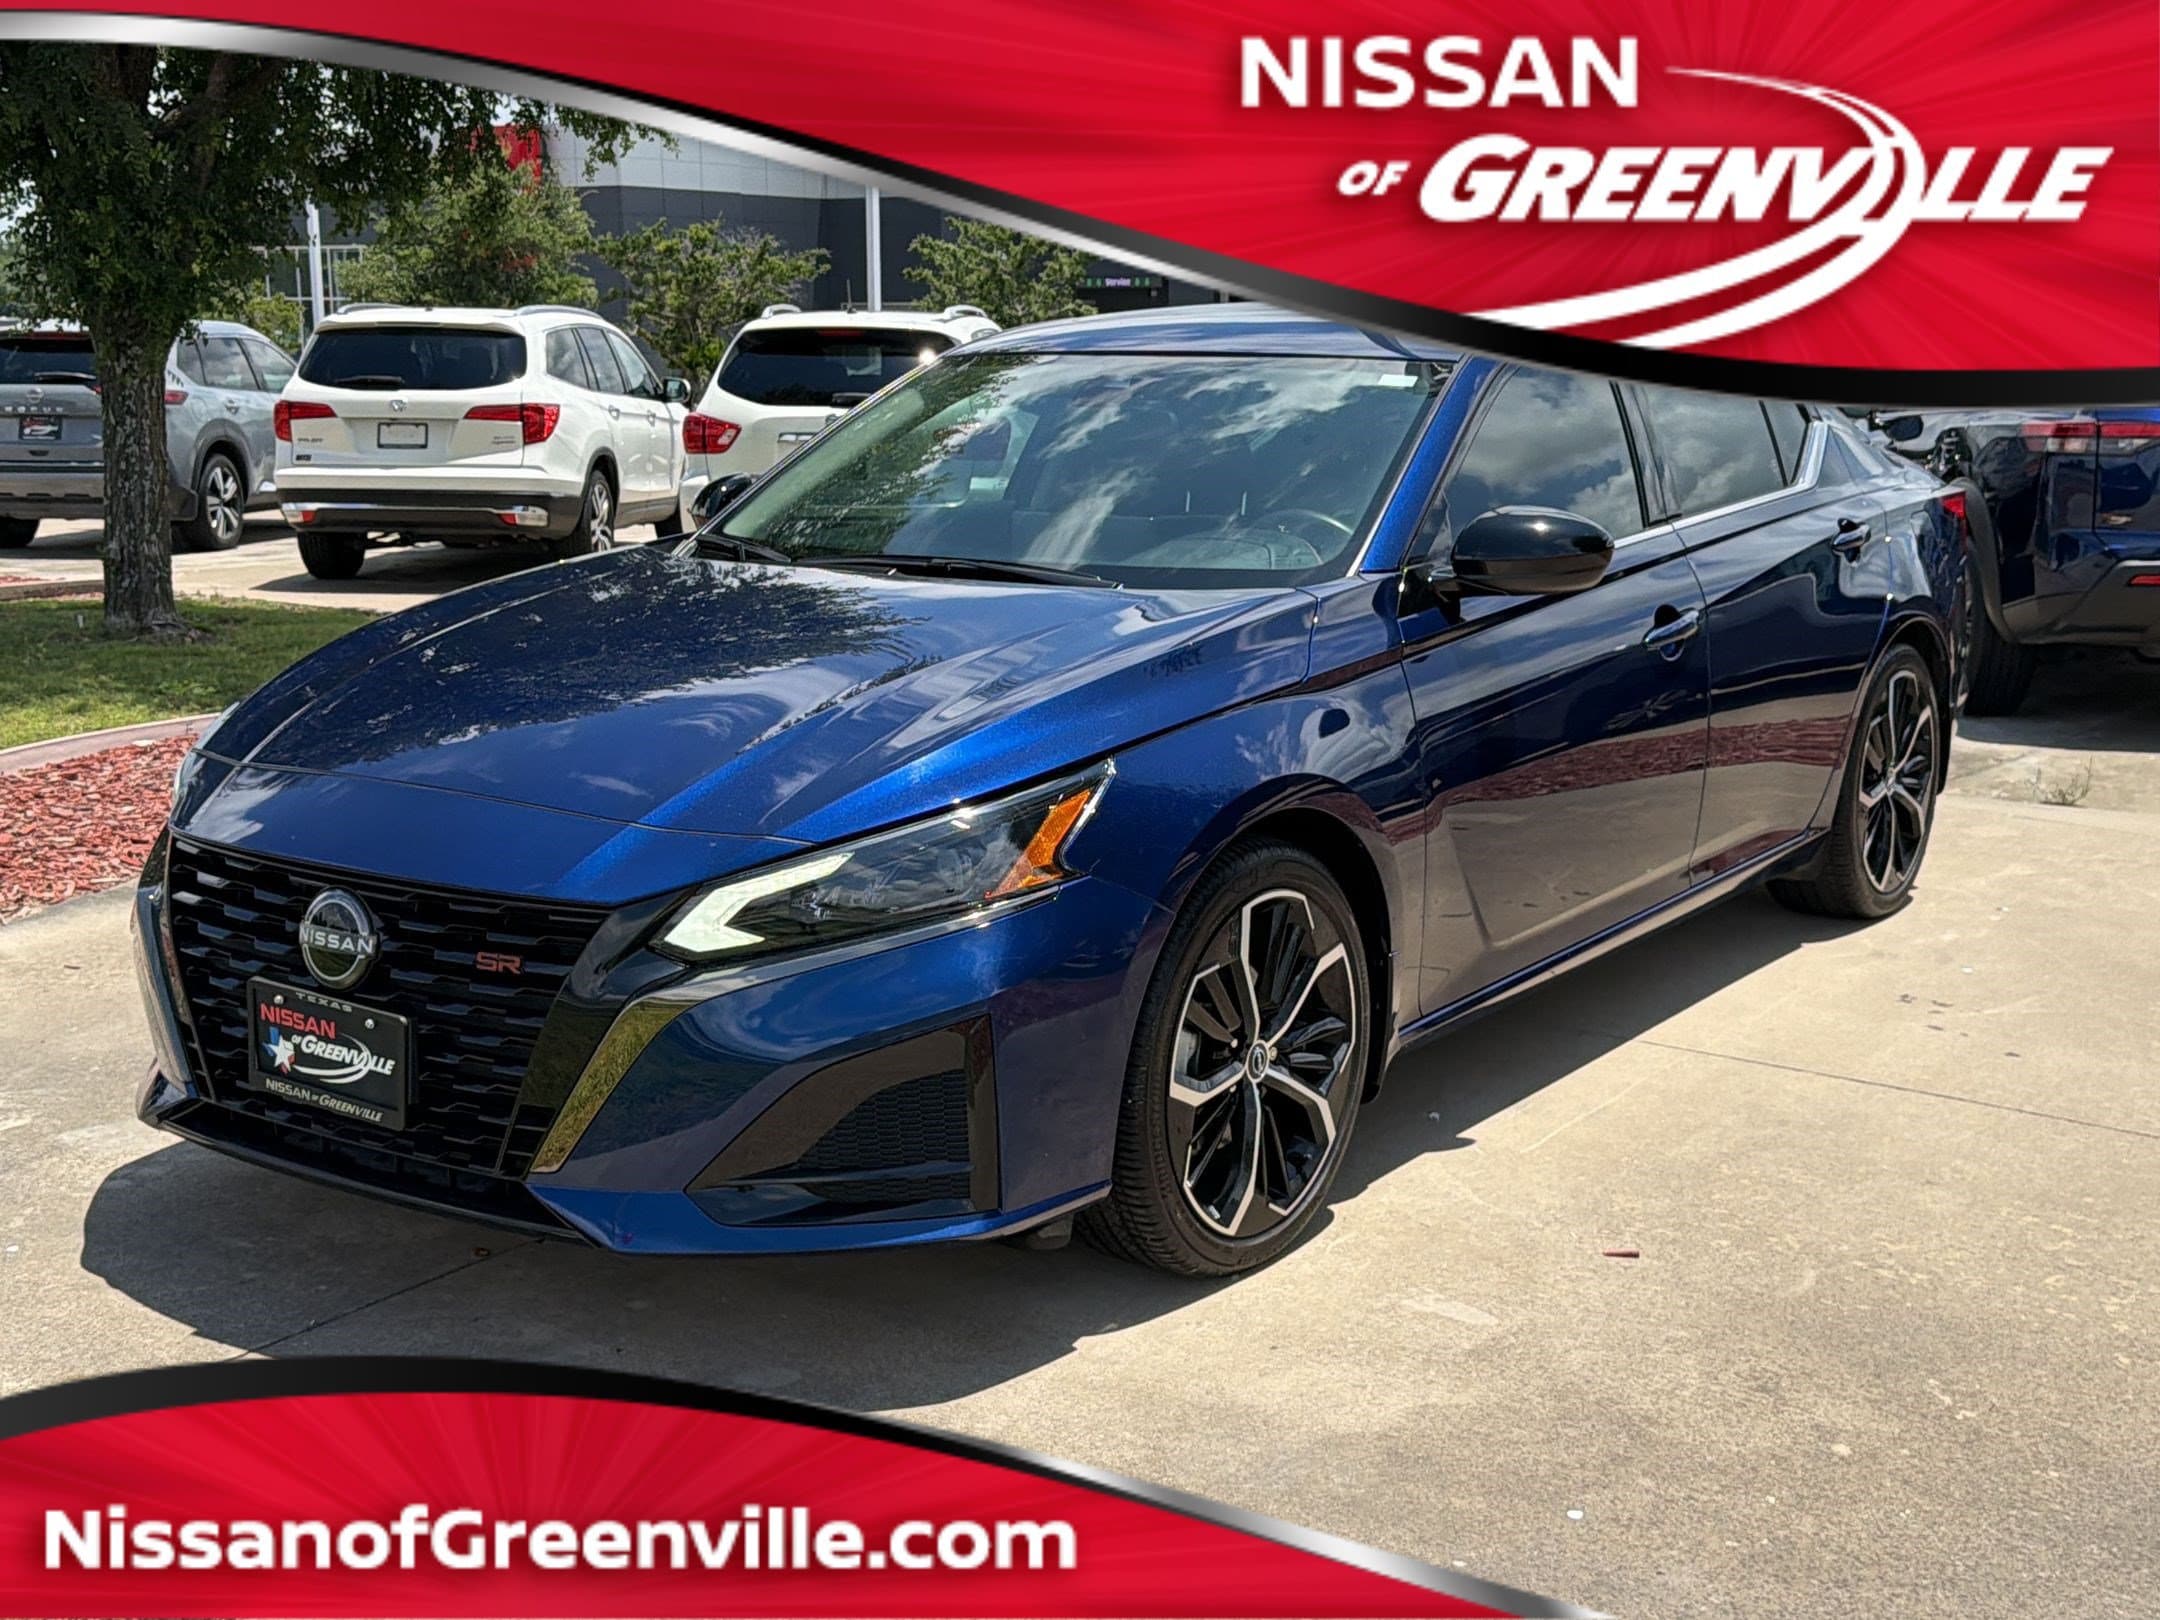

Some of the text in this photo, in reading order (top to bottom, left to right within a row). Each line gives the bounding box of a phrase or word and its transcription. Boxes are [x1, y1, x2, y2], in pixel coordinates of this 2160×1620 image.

[300, 926, 373, 953] NISSAN
[476, 951, 521, 974] SR
[295, 991, 353, 1013] TEXAS
[260, 1002, 336, 1039] NISSAN
[301, 1034, 396, 1076] GREENVILLE
[265, 1077, 311, 1101] NISSAN
[318, 1094, 384, 1123] GREENVILLE
